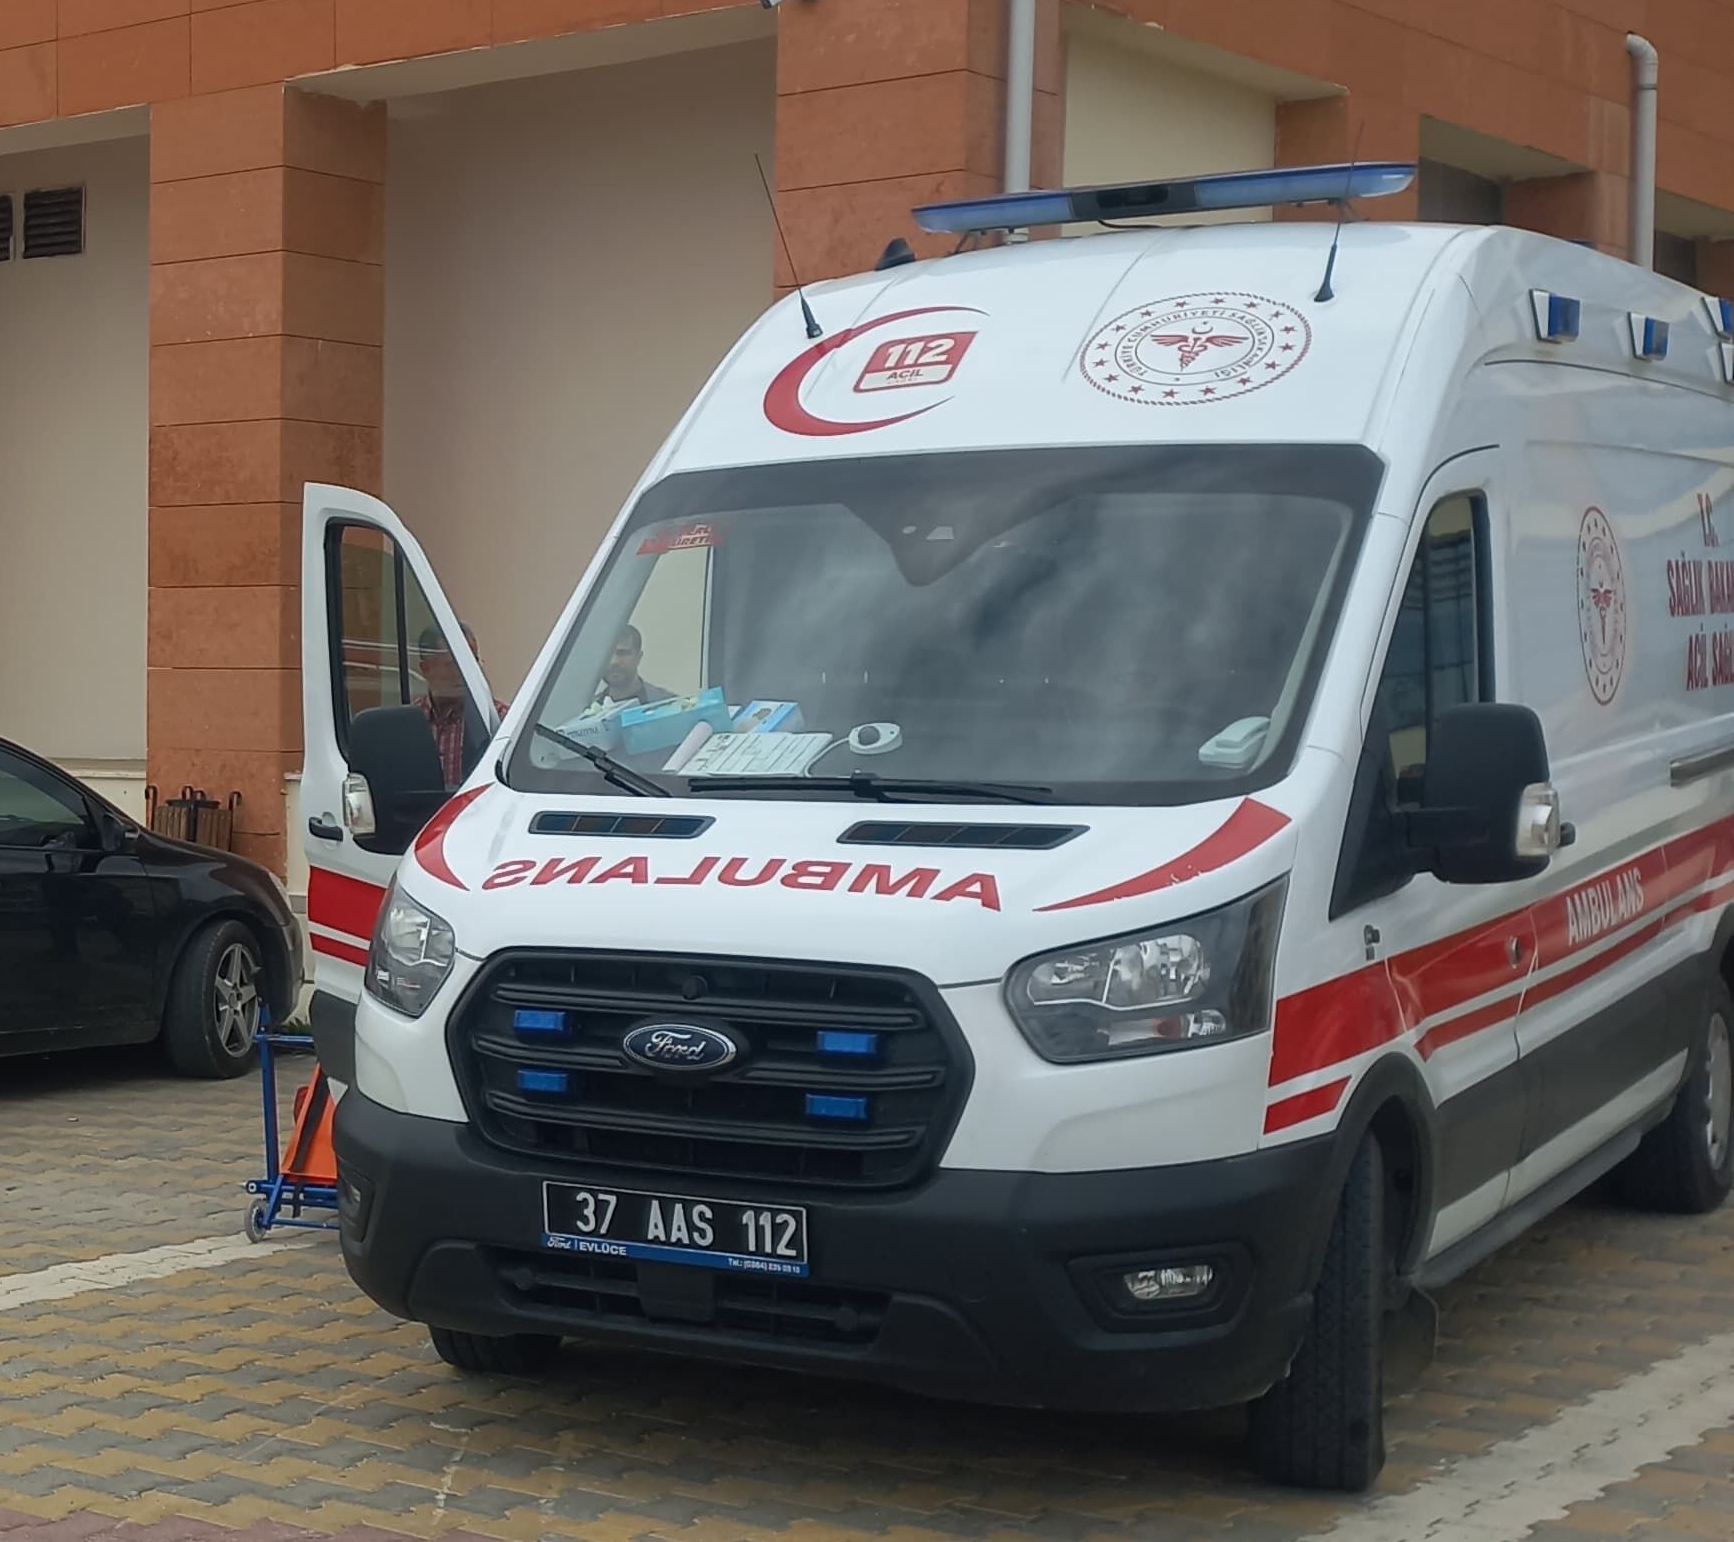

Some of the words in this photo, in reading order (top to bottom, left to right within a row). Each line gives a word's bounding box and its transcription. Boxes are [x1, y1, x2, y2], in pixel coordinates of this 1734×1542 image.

[884, 338, 955, 369] 112
[1566, 866, 1644, 947] AMBULANS
[645, 1030, 706, 1060] Ford
[576, 1191, 617, 1235] 37
[647, 1199, 714, 1247] AAS
[741, 1209, 797, 1257] 112
